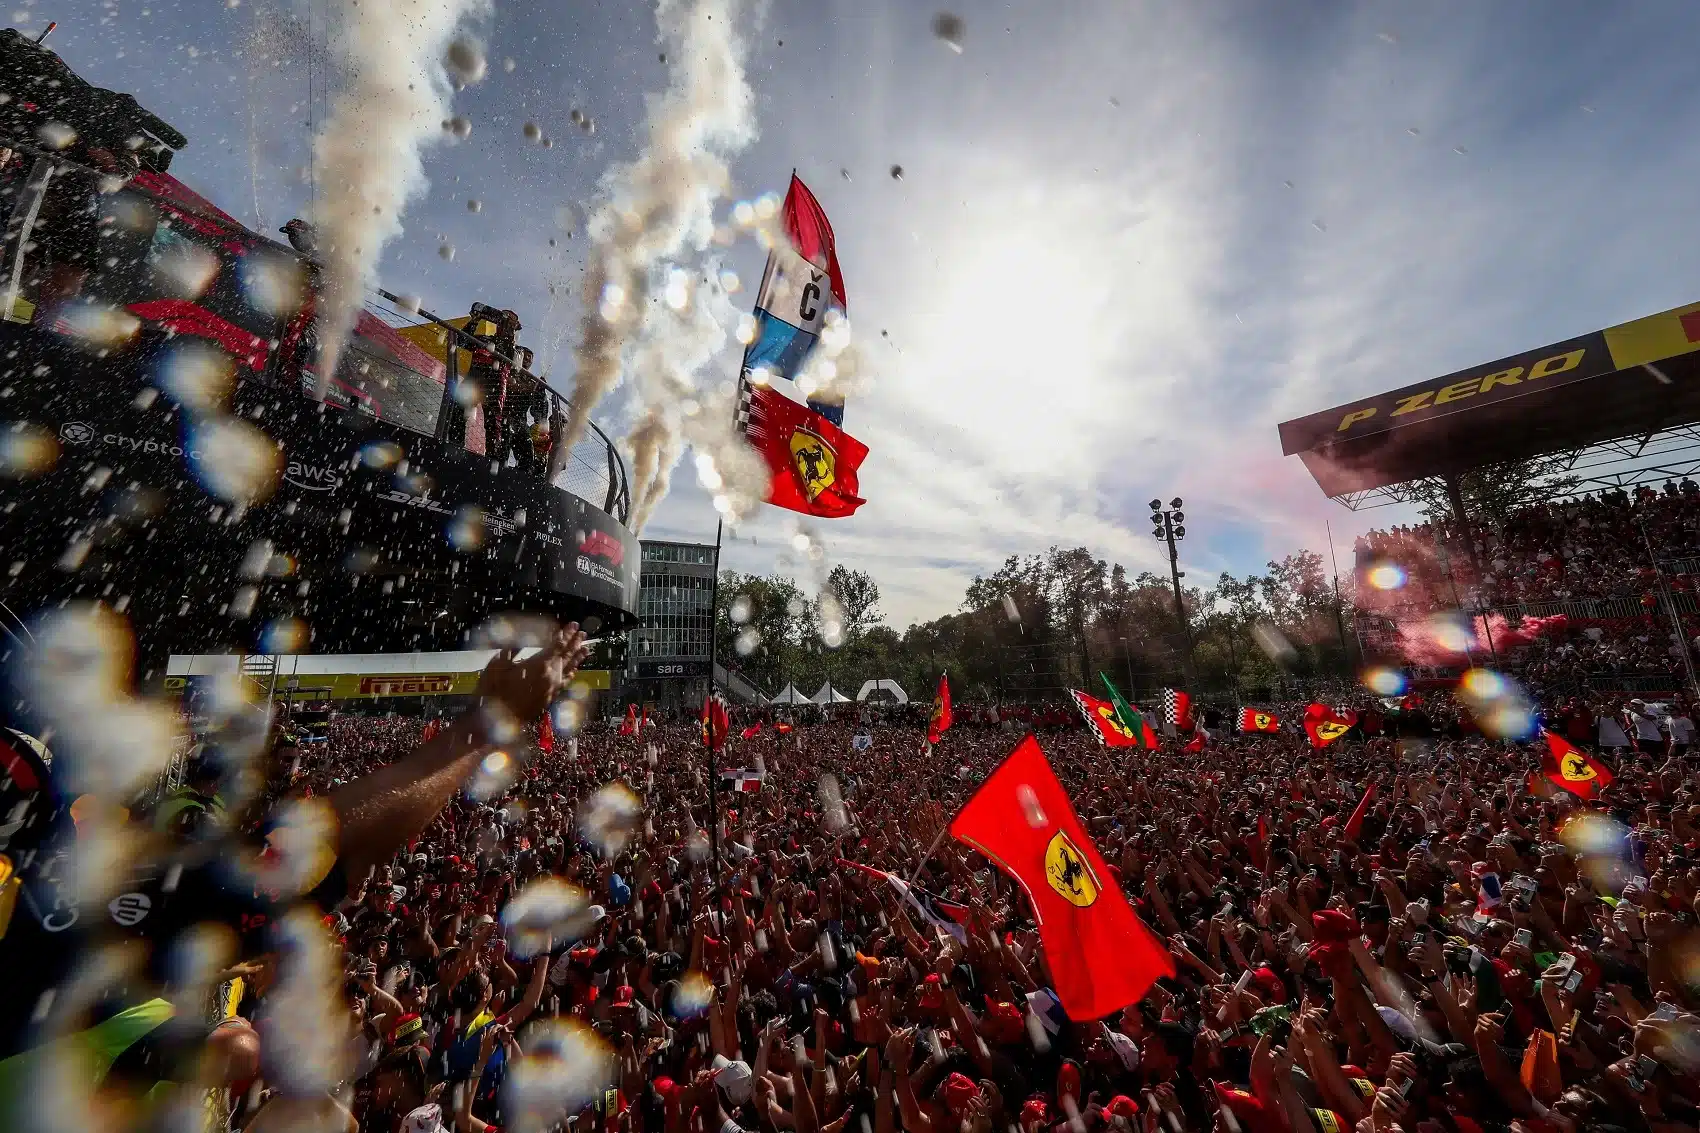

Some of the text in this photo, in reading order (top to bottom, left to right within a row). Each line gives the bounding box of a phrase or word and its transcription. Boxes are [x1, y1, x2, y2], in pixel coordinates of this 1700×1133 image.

[798, 268, 824, 322] Č
[1337, 348, 1587, 432] P ZERO
[286, 460, 337, 483] aws
[482, 514, 515, 530] Heineken
[535, 531, 563, 547] ROLEX
[657, 664, 683, 674] sara
